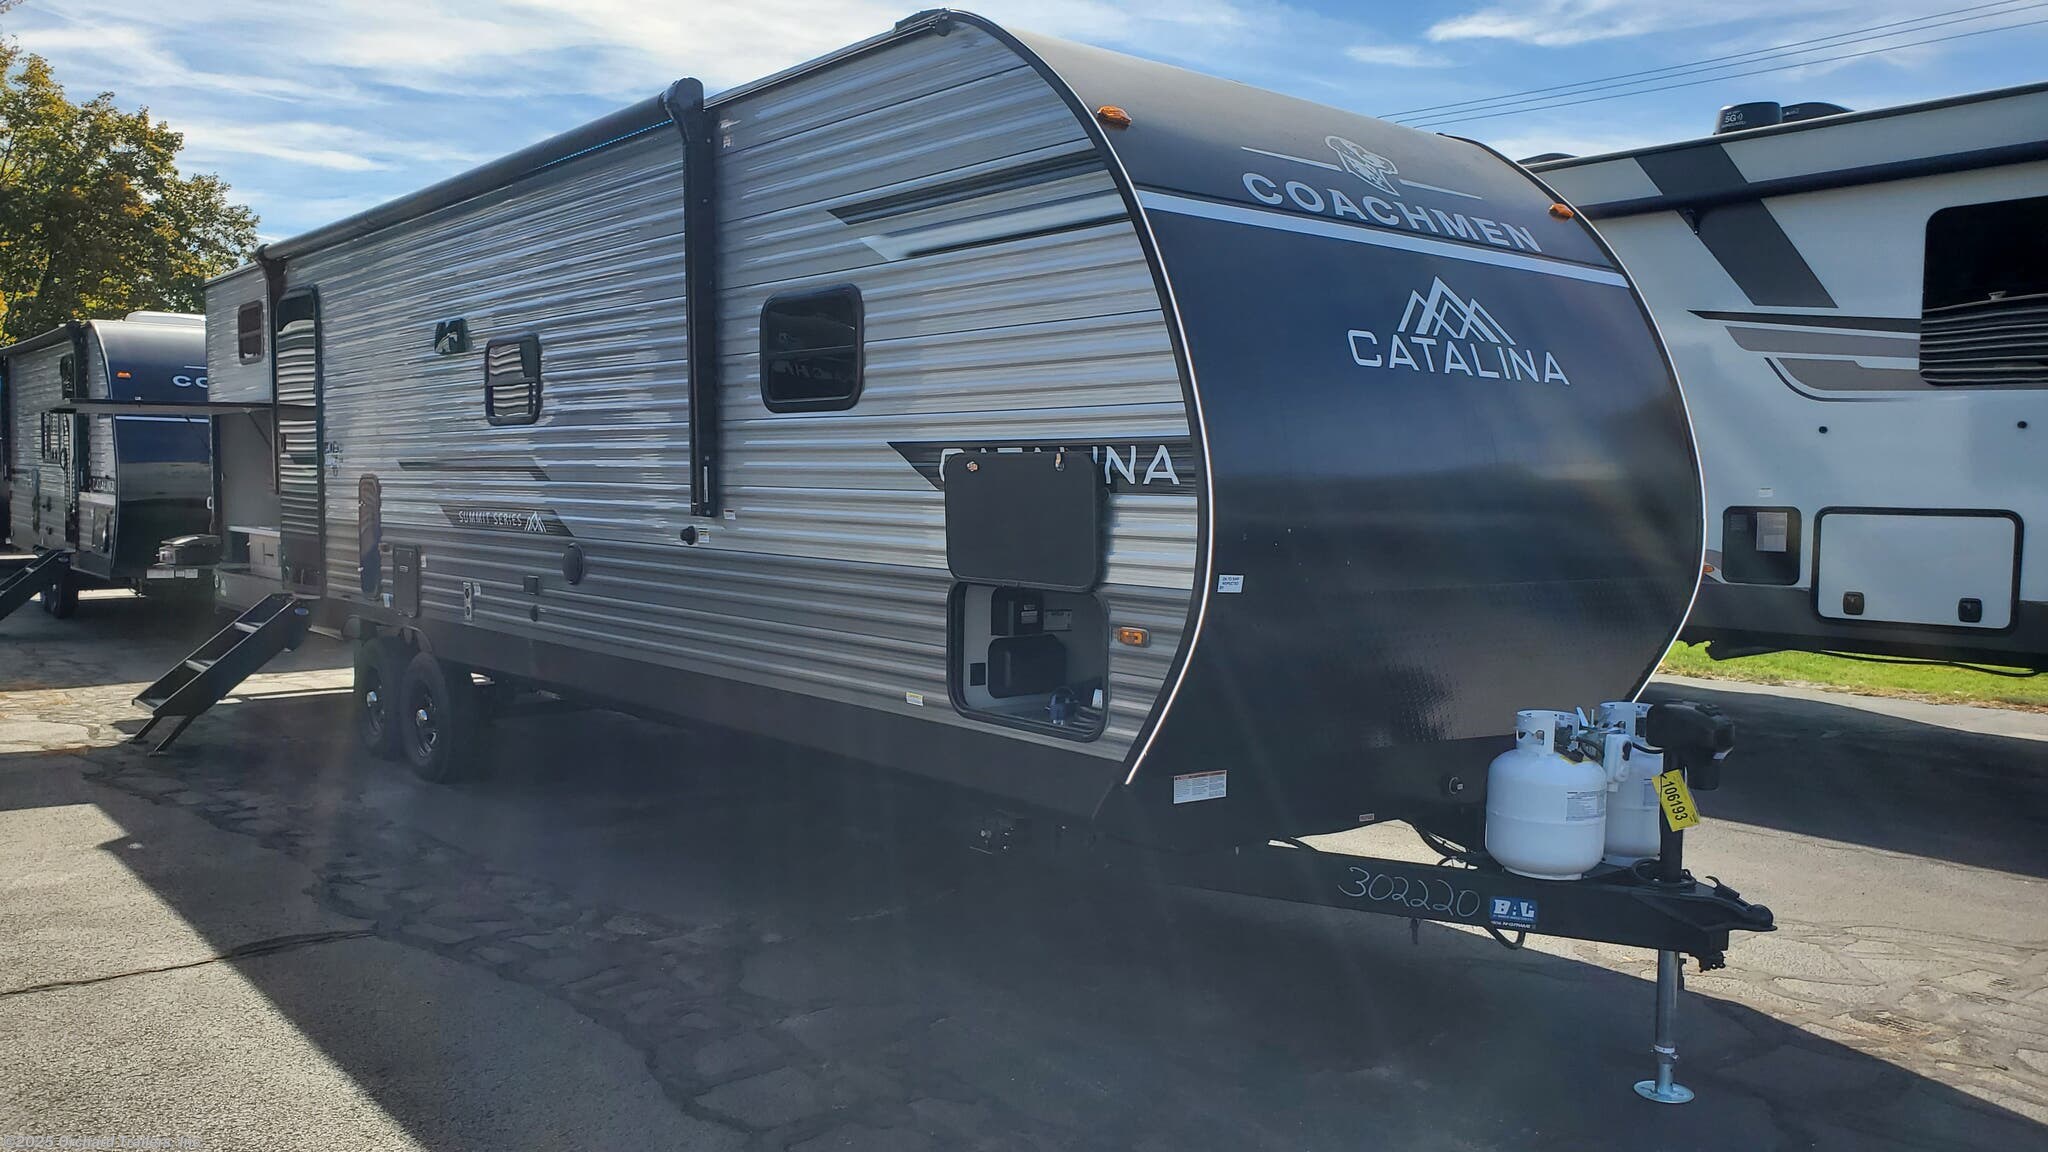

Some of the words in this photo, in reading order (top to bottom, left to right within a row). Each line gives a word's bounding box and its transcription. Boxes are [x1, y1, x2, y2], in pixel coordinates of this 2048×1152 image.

[1242, 172, 1543, 253] COACHMEN
[1347, 329, 1571, 386] CATALINA
[458, 510, 490, 524] SUMMIT
[493, 511, 522, 527] SERIES
[1662, 781, 1688, 821] 106193
[1337, 866, 1481, 917] 302220
